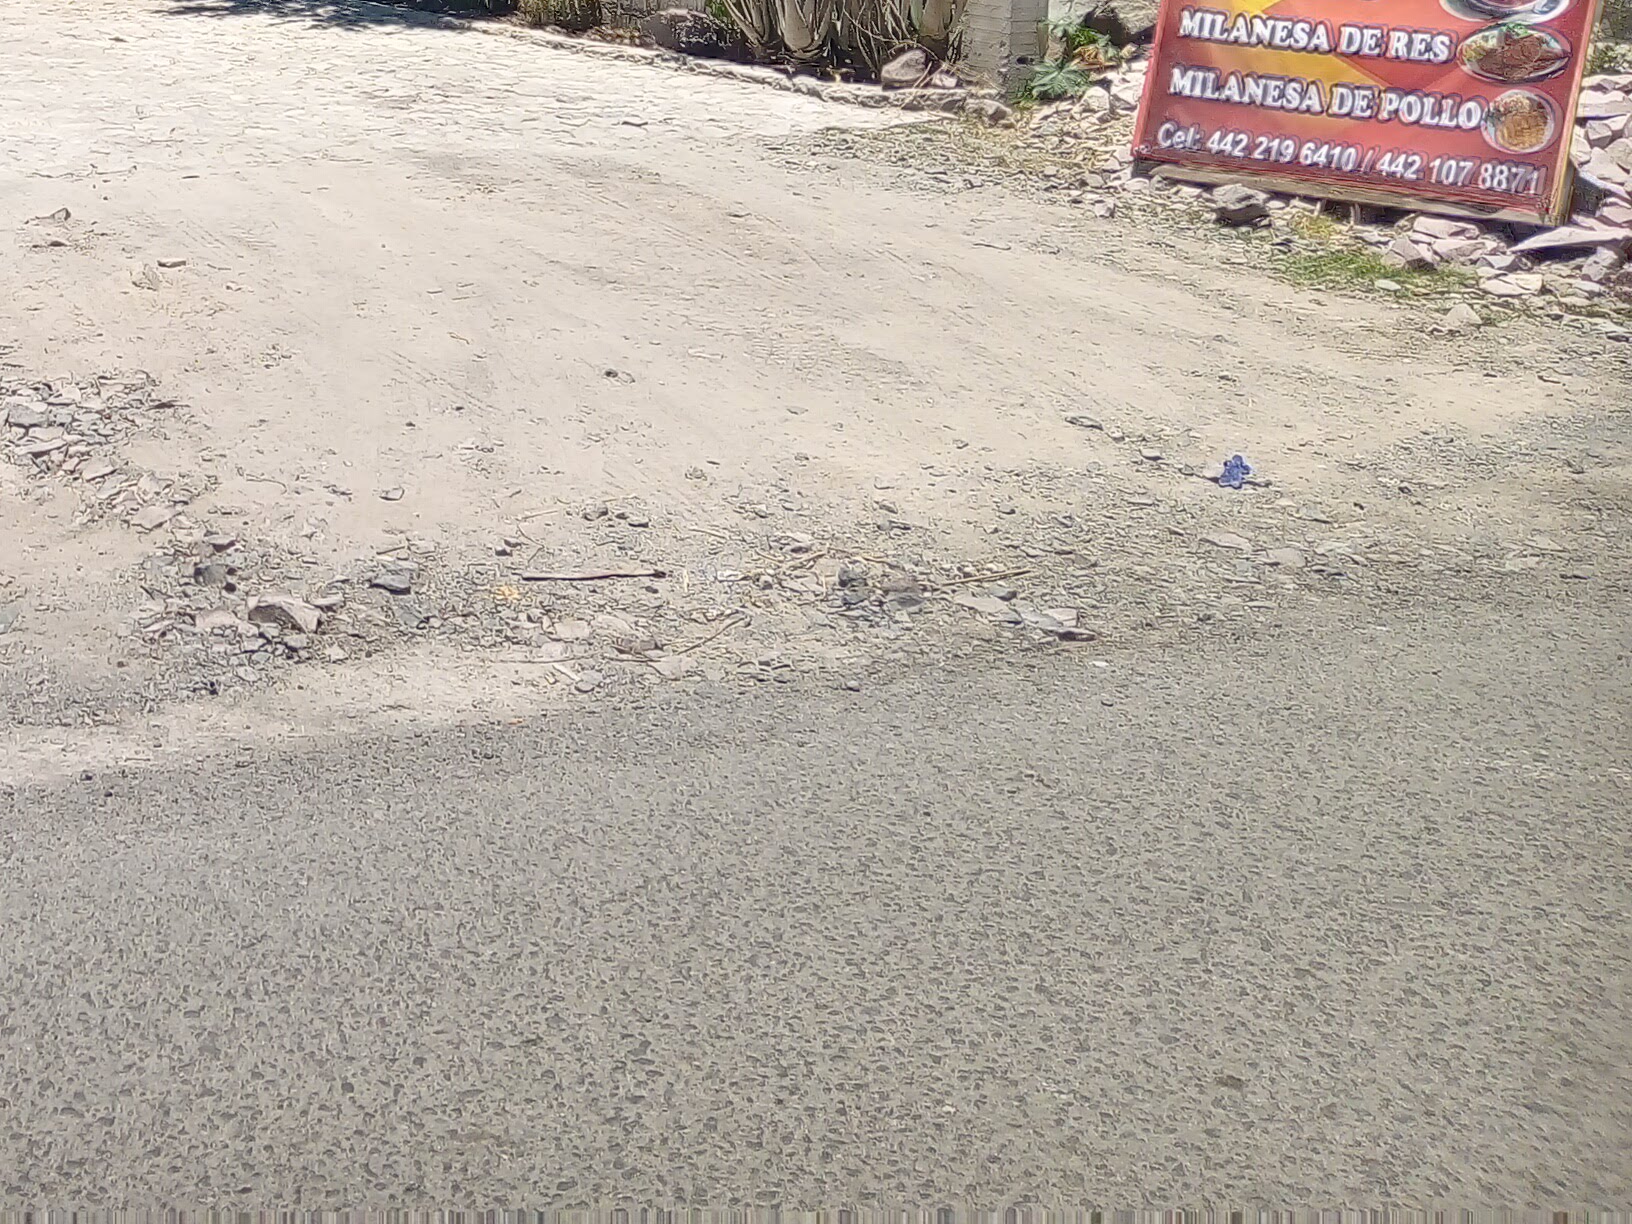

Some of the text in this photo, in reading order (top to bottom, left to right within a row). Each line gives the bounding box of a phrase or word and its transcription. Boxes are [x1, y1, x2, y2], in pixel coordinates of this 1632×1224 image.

[1178, 8, 1455, 64] MILANESA DE RES
[1168, 66, 1483, 129] MILANESA DE POLLO
[1156, 122, 1541, 195] Cel: 442 219 6410 / 442 107 8871
